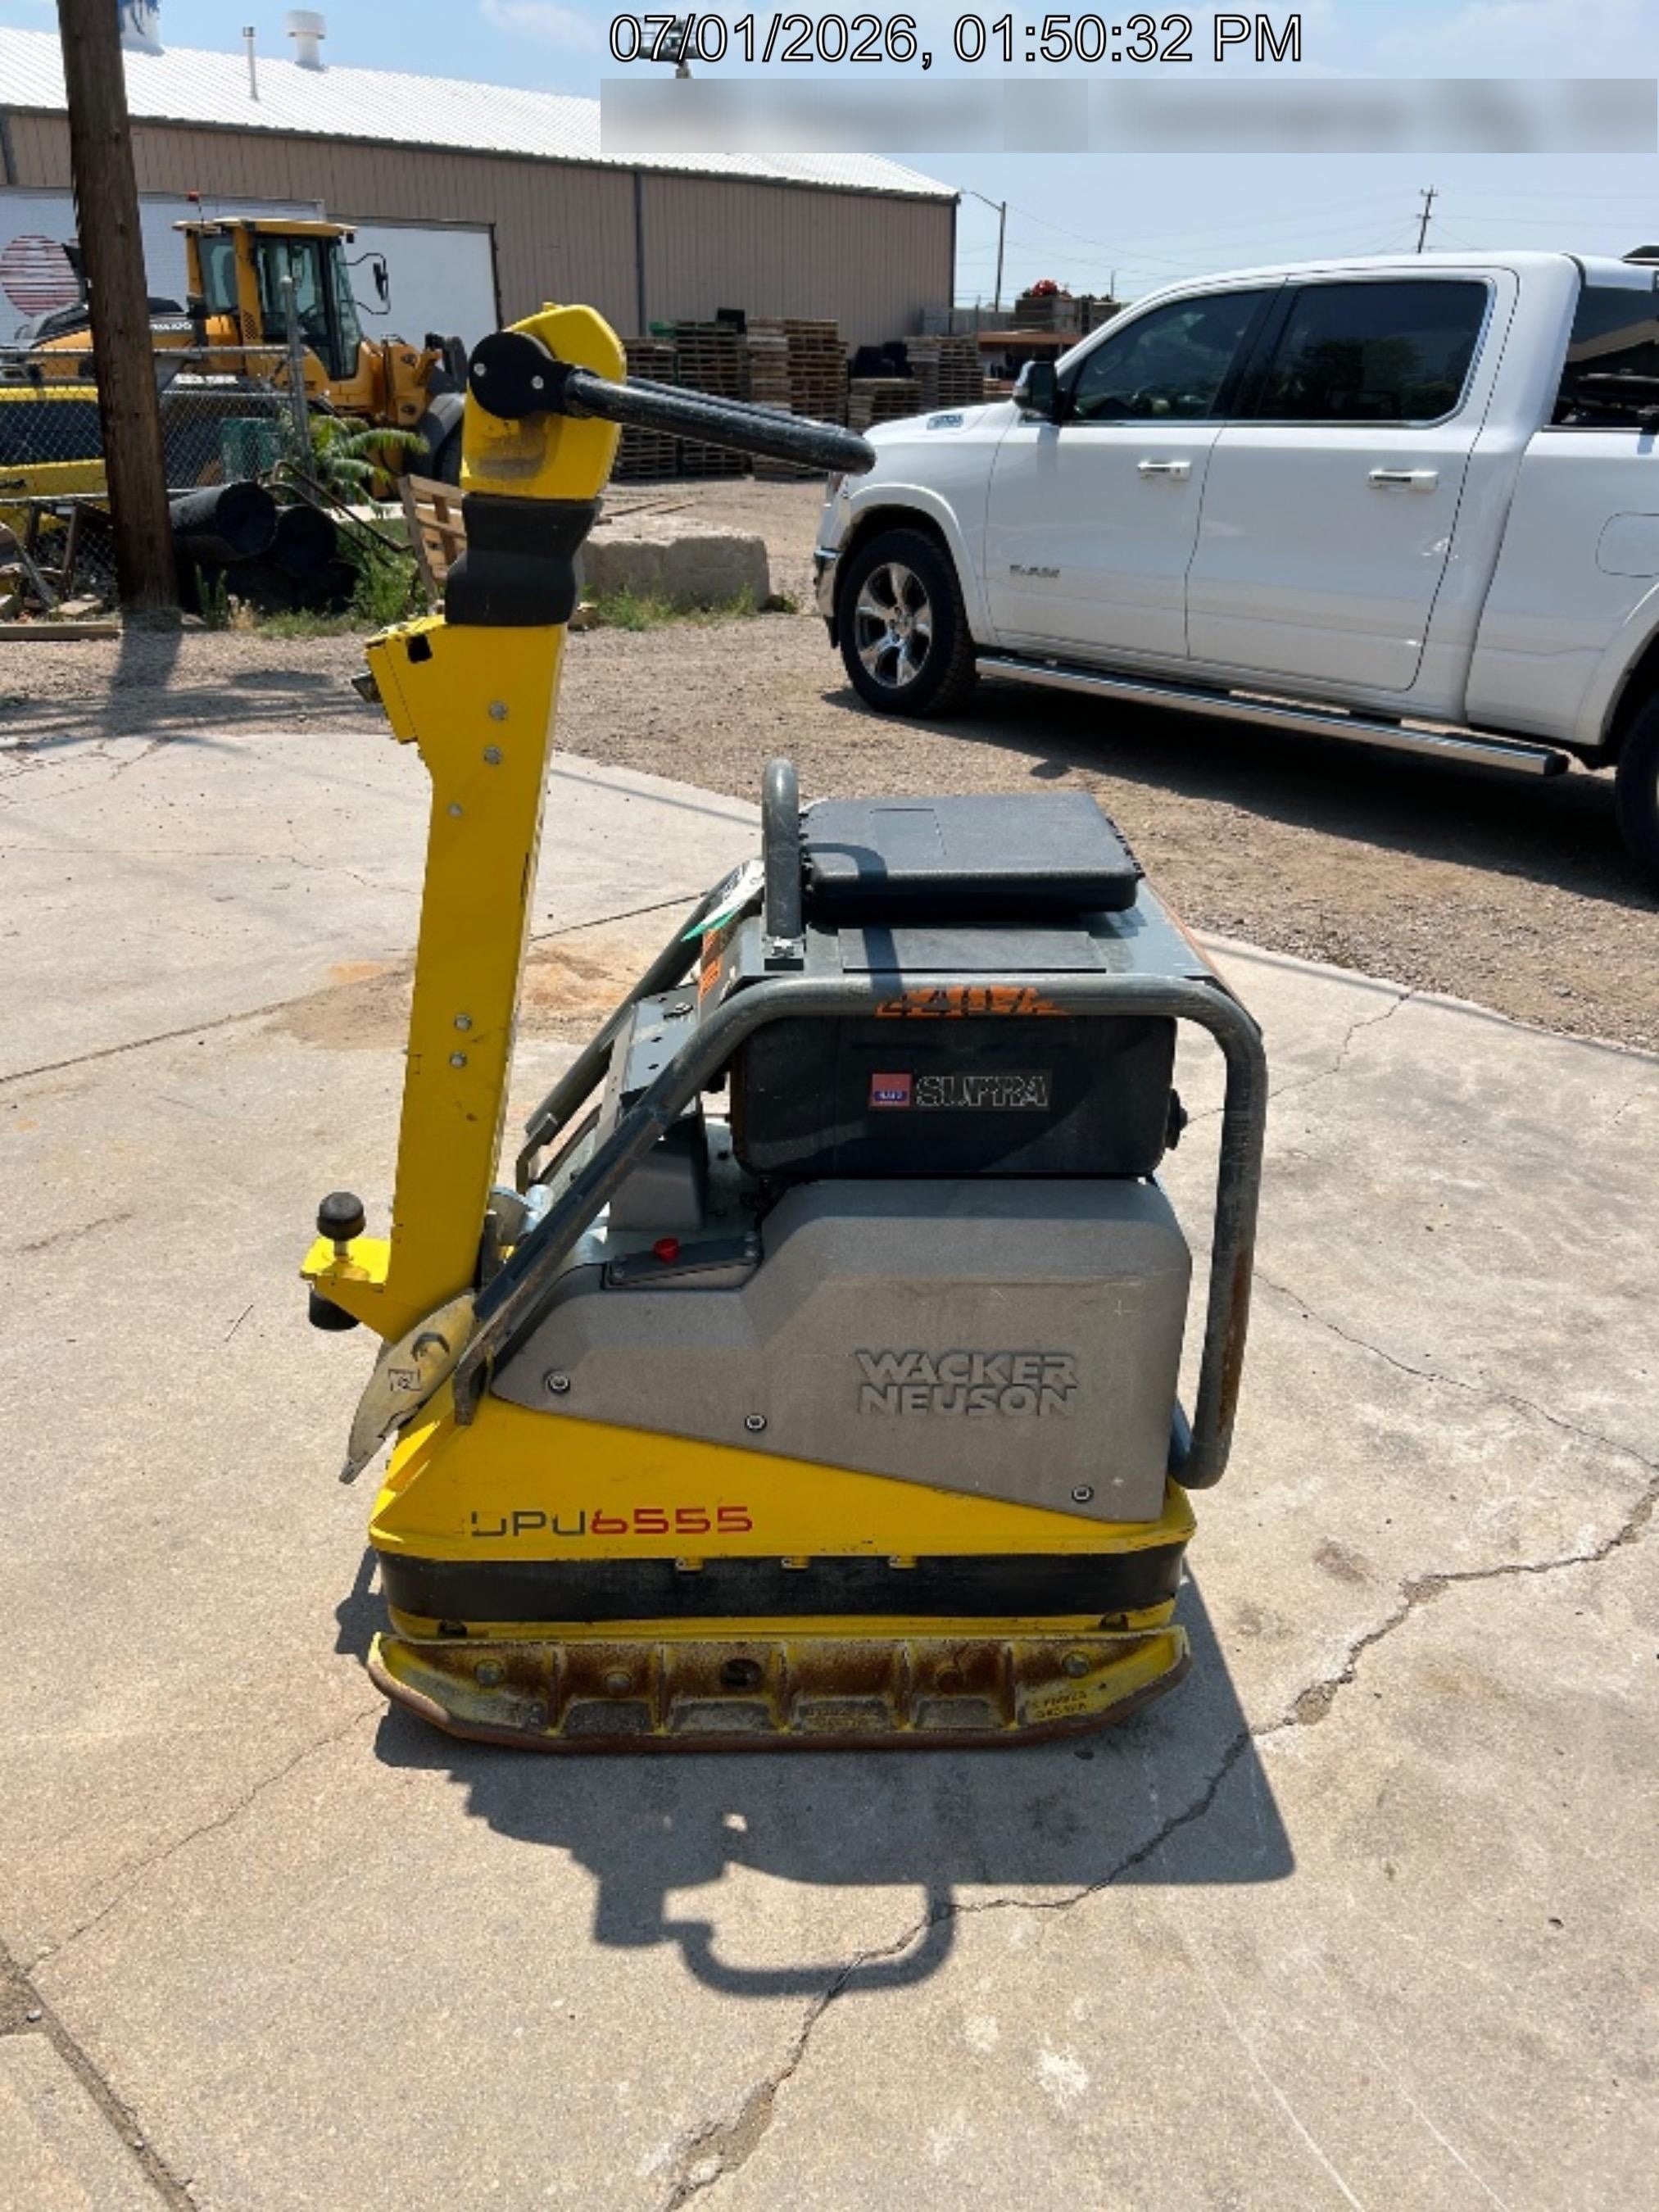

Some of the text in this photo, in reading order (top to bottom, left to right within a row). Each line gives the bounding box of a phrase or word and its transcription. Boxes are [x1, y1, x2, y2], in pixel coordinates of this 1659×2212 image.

[915, 1075, 1049, 1107] SUPRA
[854, 1348, 1079, 1388] WACKER
[858, 1384, 1077, 1418] NEUSON
